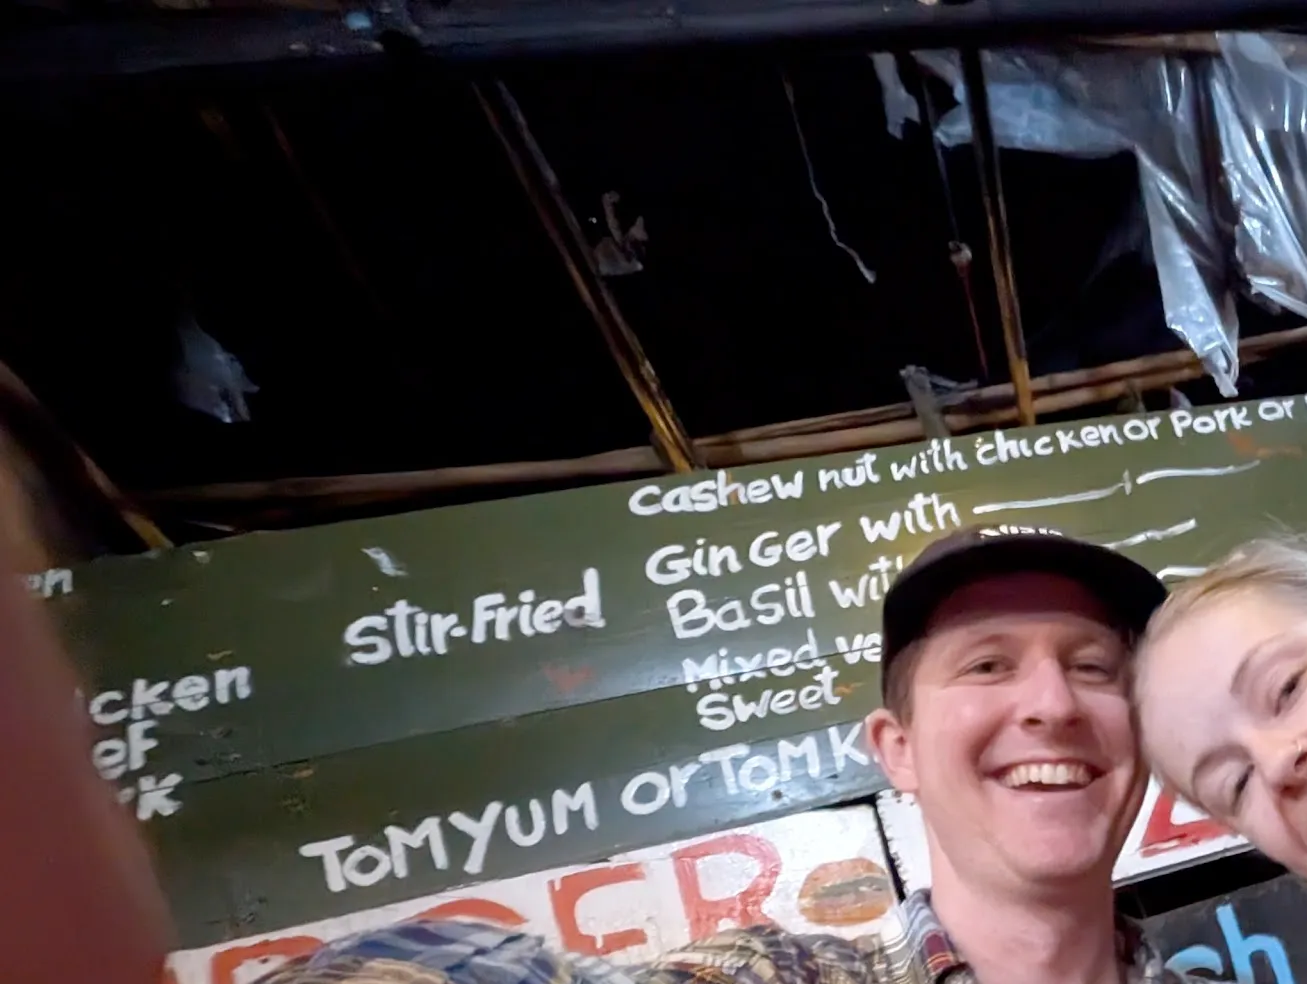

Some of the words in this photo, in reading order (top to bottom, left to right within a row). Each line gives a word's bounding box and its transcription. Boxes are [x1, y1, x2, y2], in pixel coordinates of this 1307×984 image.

[629, 470, 804, 515] Cashew
[818, 453, 881, 491] nut
[891, 437, 968, 481] with
[1258, 397, 1295, 422] or
[860, 492, 961, 543] with
[682, 628, 827, 693] Mixed
[835, 632, 883, 664] ve
[80, 666, 251, 724] cken
[696, 665, 842, 730] Sweet
